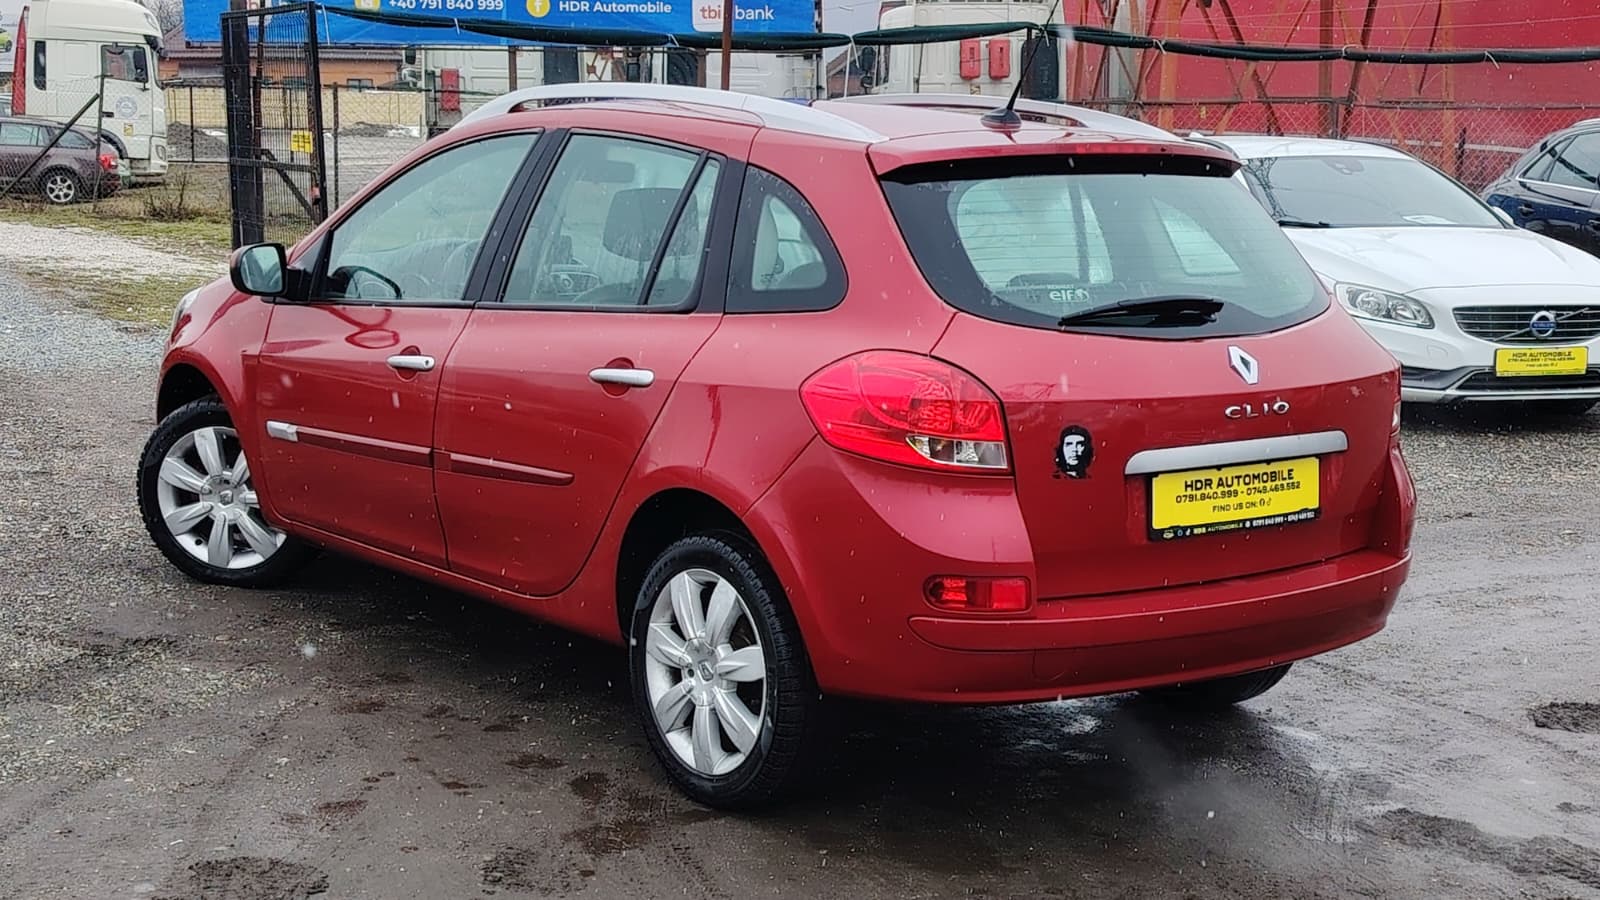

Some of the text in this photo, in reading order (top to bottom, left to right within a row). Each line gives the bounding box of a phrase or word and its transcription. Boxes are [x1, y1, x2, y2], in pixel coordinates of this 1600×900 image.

[389, 0, 416, 9] +40
[421, 0, 442, 9] 791
[477, 0, 504, 10] 999
[559, 1, 672, 14] HDR Automobile
[700, 5, 775, 20] tbi bank
[1050, 290, 1074, 301] elf
[1225, 401, 1290, 418] CLIO
[1184, 469, 1294, 492] HDR AUTOMOBILE
[1175, 489, 1239, 504] 0791.840.999
[1212, 504, 1231, 513] FIND
[1233, 502, 1244, 511] US
